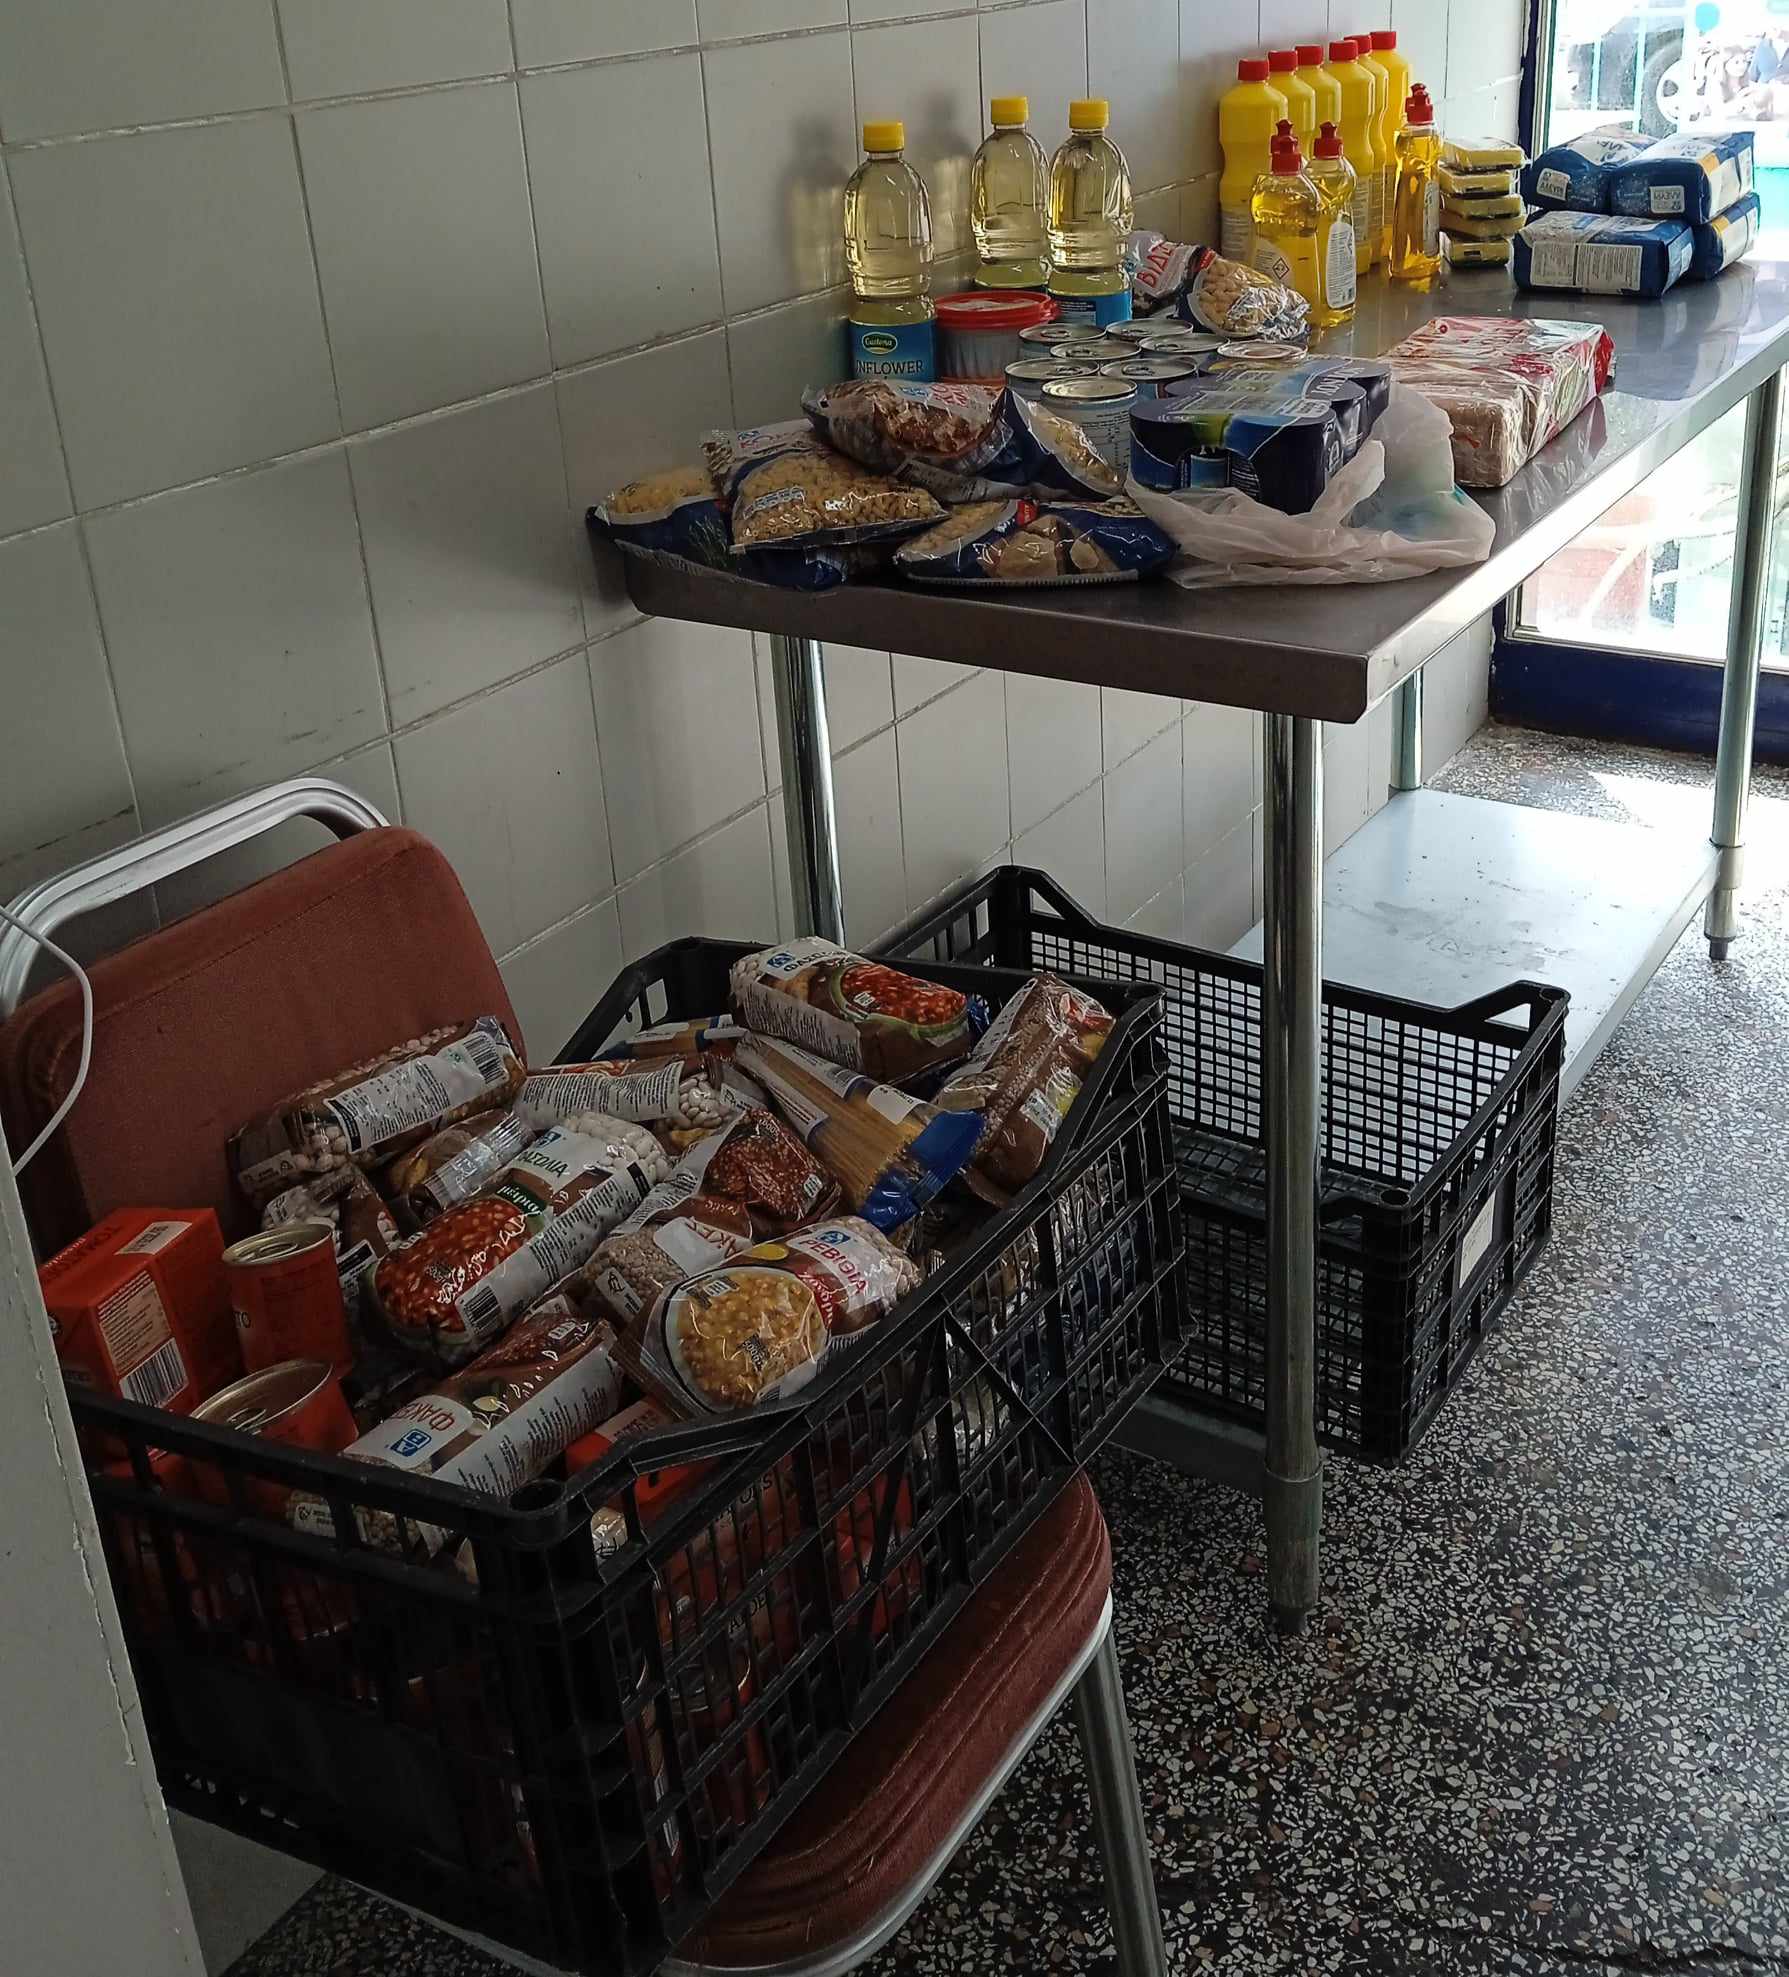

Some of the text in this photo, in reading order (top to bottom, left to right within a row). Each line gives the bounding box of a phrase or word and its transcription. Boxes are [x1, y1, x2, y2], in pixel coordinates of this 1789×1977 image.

[855, 359, 924, 375] NFLOWER
[518, 1150, 568, 1178] ΑΣΟΛΙΑ
[799, 1238, 868, 1294] ΡΕΒΙΘΙΑ
